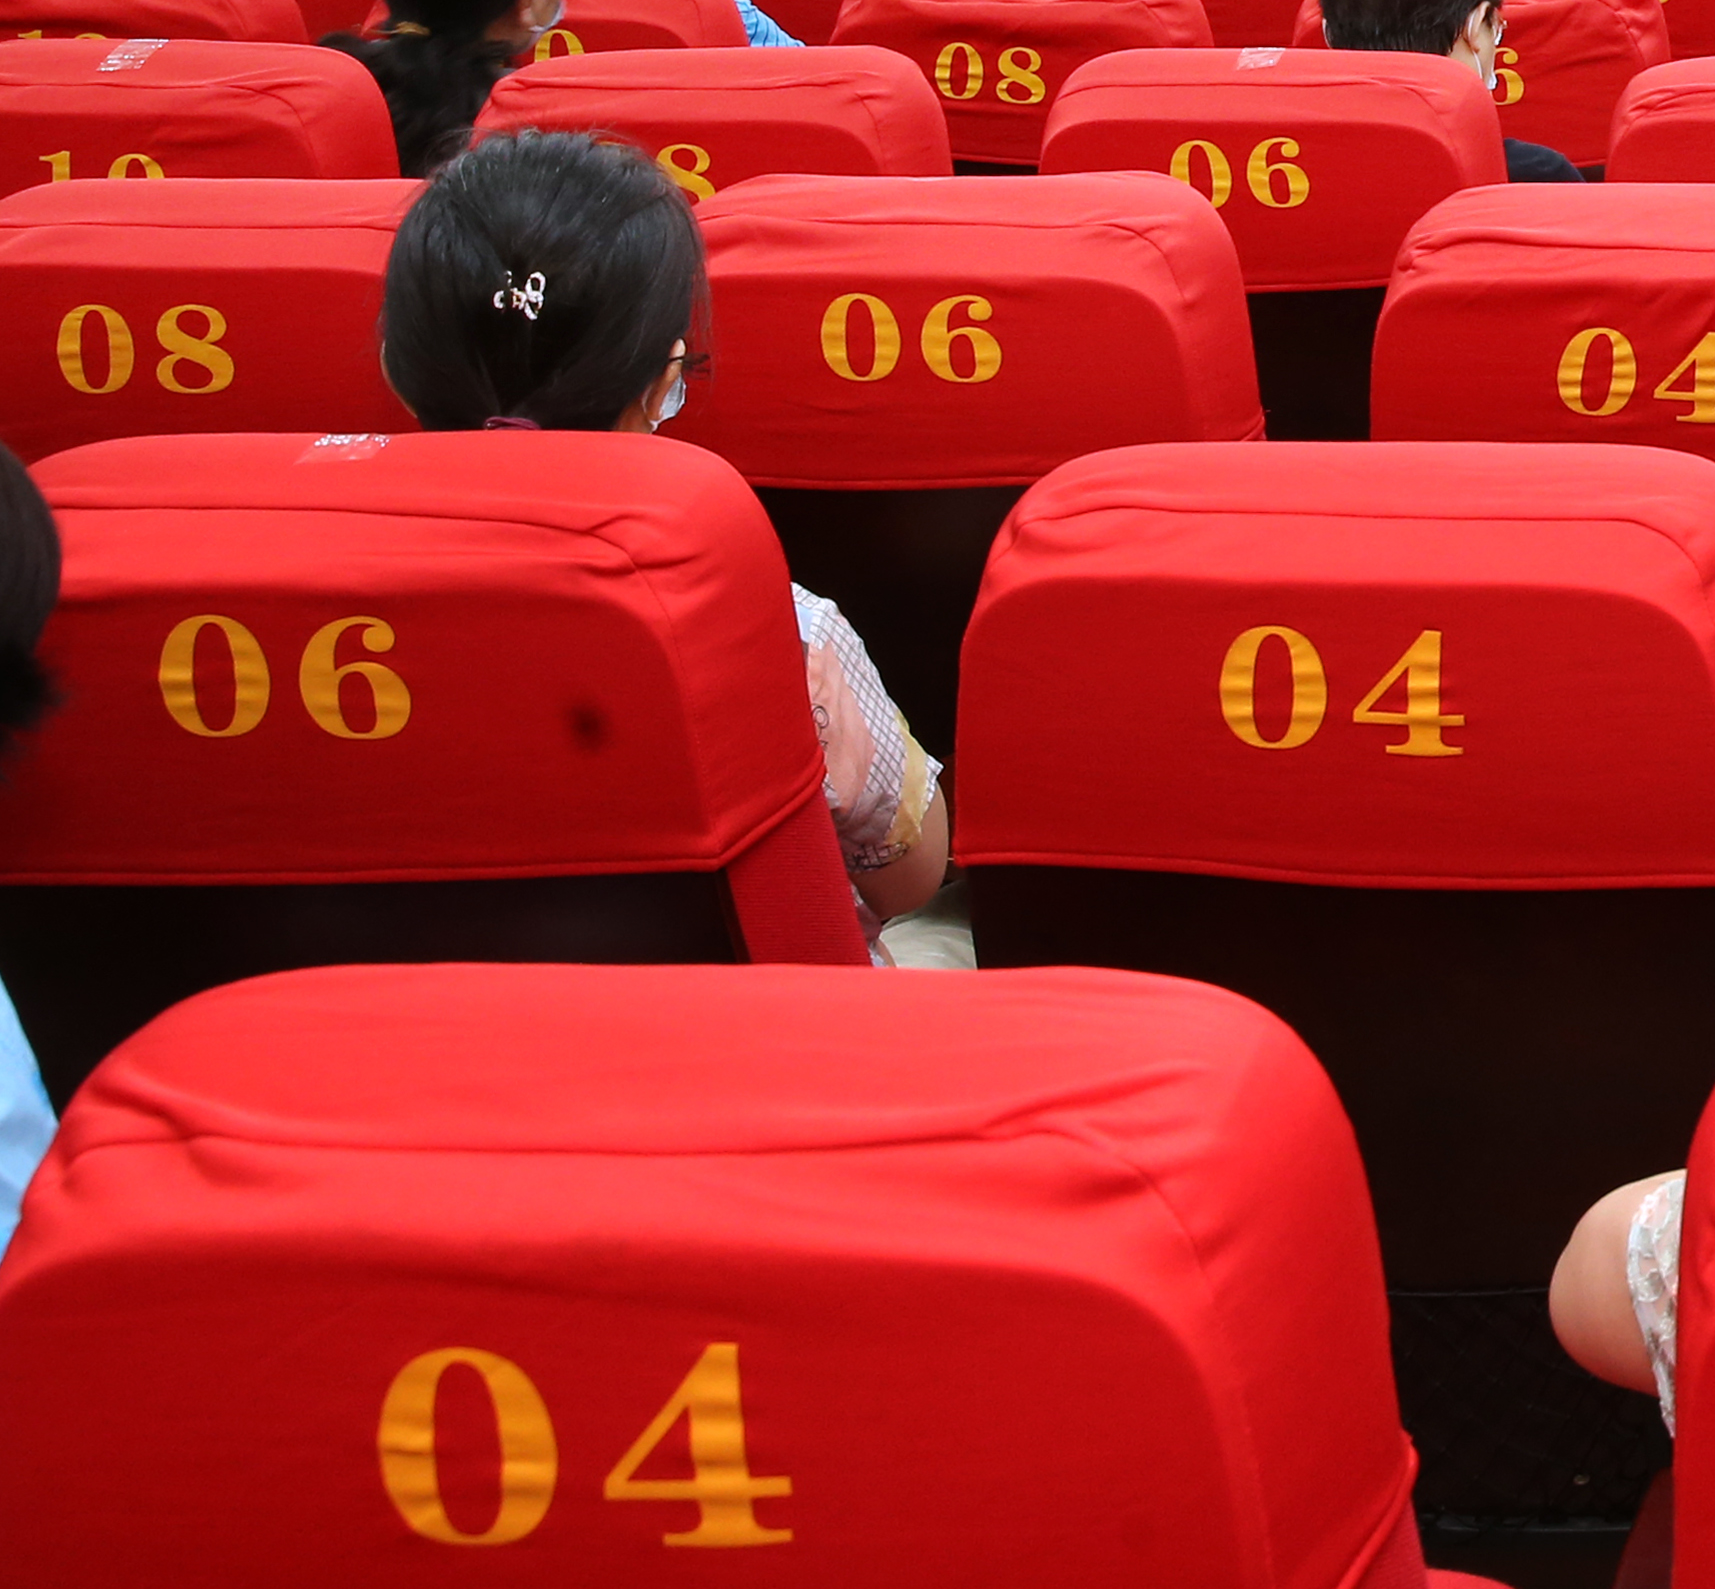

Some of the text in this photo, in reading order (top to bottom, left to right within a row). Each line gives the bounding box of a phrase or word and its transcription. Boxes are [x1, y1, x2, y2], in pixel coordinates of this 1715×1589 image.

[935, 42, 1047, 105] 08
[1170, 137, 1311, 209] 06
[58, 305, 236, 395] 08
[822, 294, 1004, 384] 06
[160, 616, 412, 740] 06
[1221, 626, 1466, 757] 04
[380, 1343, 793, 1547] 04
